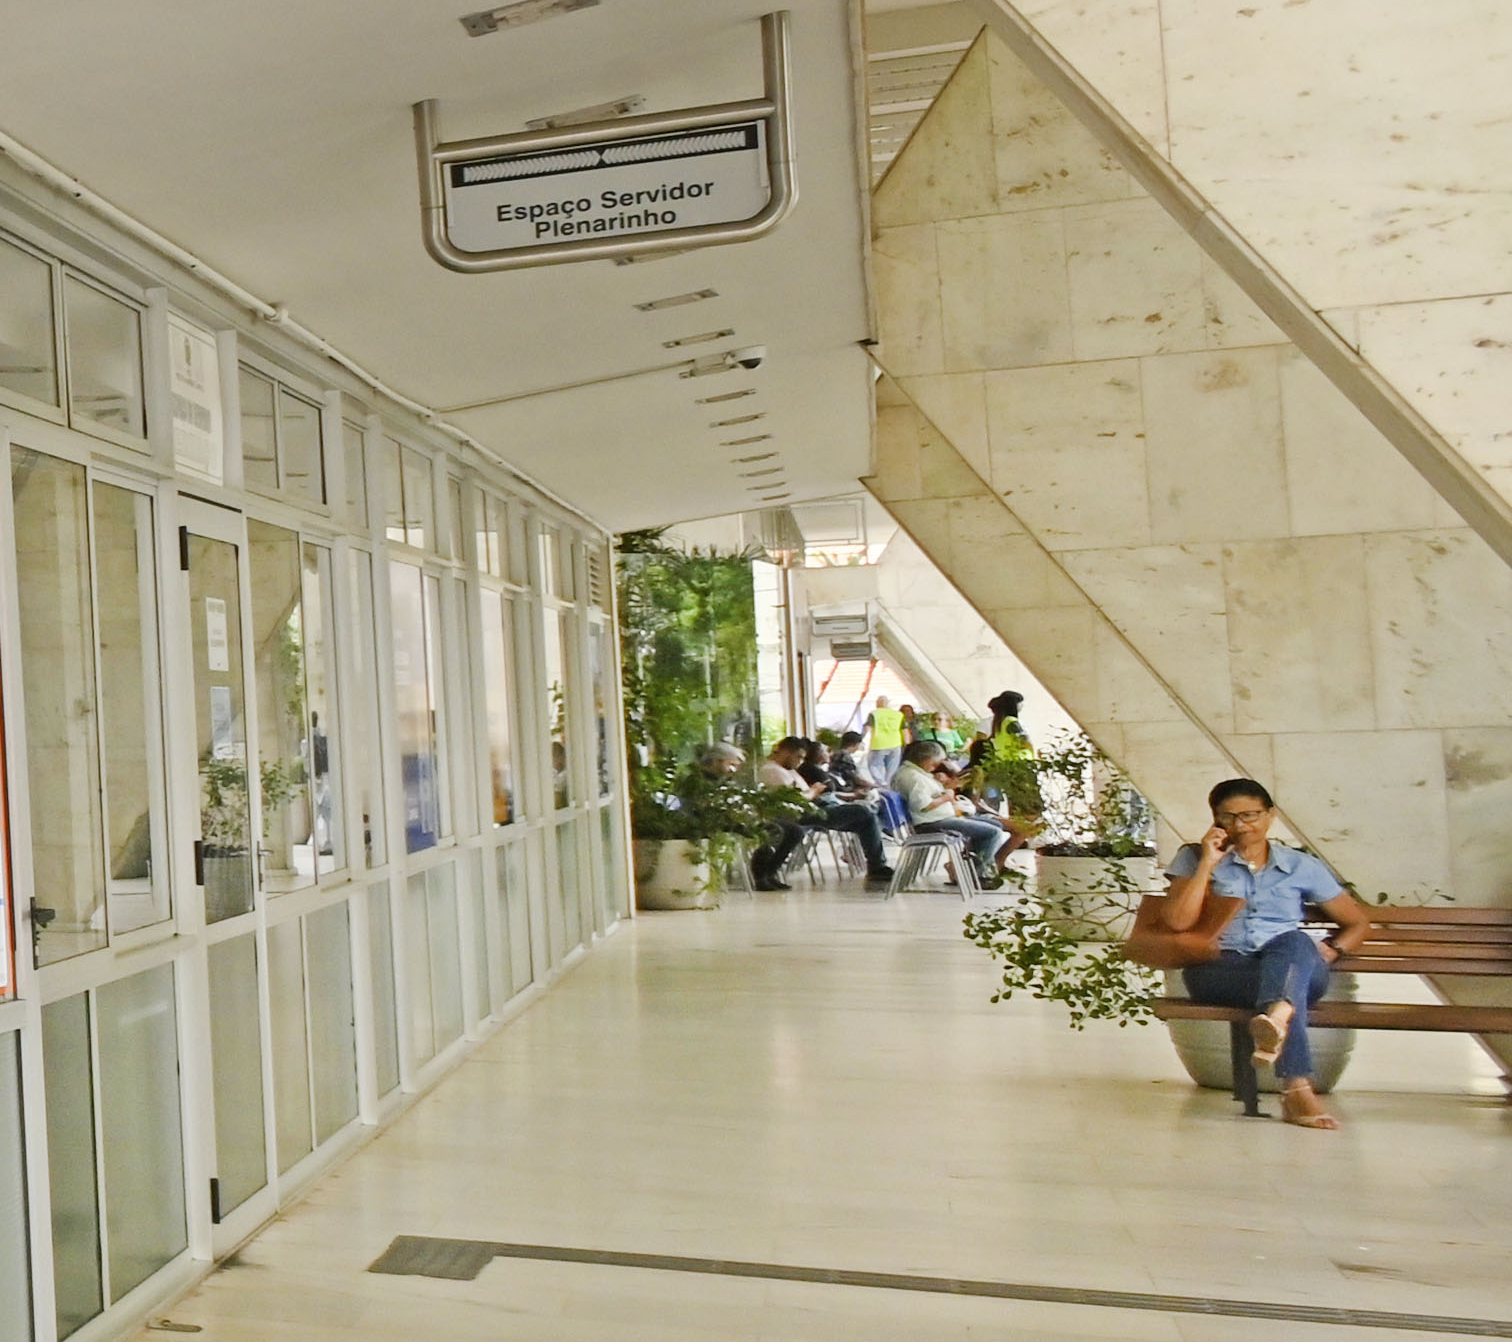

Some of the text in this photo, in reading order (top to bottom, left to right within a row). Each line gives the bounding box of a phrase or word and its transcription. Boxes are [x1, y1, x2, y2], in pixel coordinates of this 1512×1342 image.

[496, 179, 715, 223] Espaço Servidor
[535, 207, 677, 239] Plenarinho
